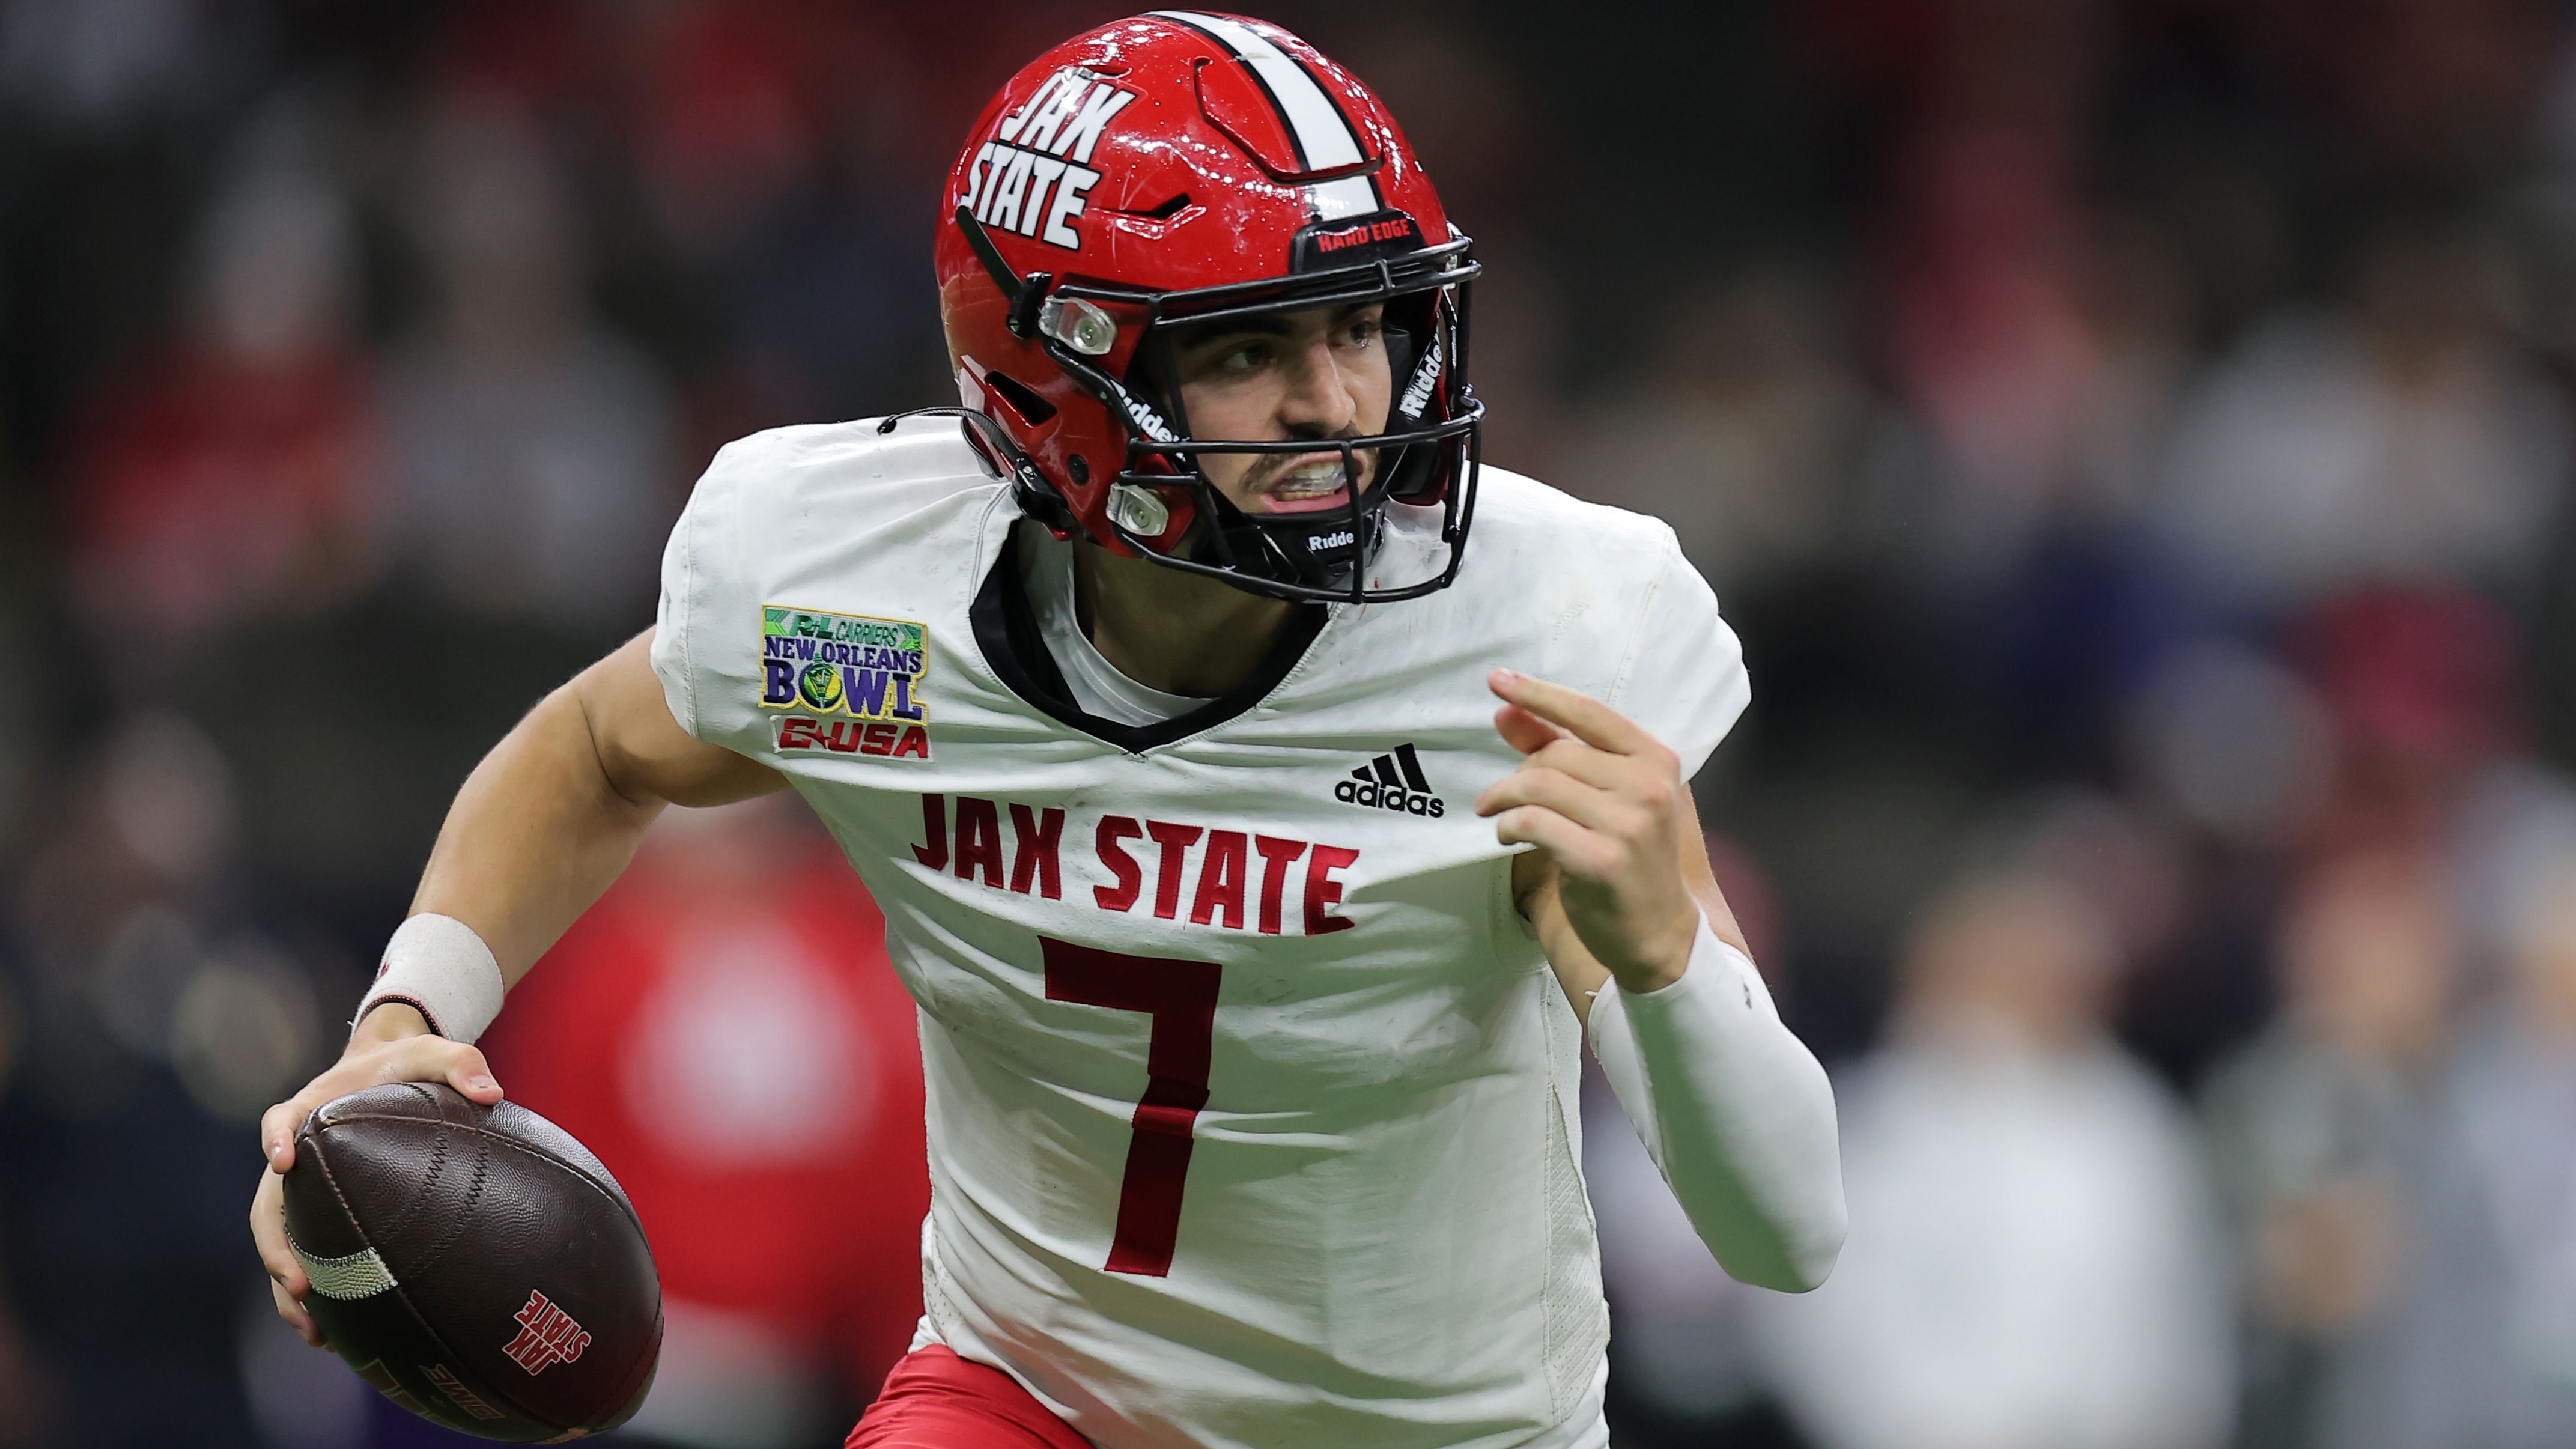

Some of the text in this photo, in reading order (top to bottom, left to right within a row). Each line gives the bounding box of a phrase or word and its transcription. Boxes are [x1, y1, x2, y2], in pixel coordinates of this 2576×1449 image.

[998, 70, 1137, 165] JAX
[960, 141, 1103, 251] STATE
[1370, 218, 1411, 242] EDGE
[1399, 332, 1443, 419] Ridde
[764, 636, 922, 673] NEW ORLEANS
[836, 621, 898, 648] CARRIERS
[763, 658, 922, 720] BOWL
[1335, 781, 1444, 818] adidas
[910, 793, 1360, 936] JAX STATE
[1037, 935, 1223, 1278] 7
[500, 1325, 562, 1377] JAX
[512, 1287, 593, 1365] STATE
